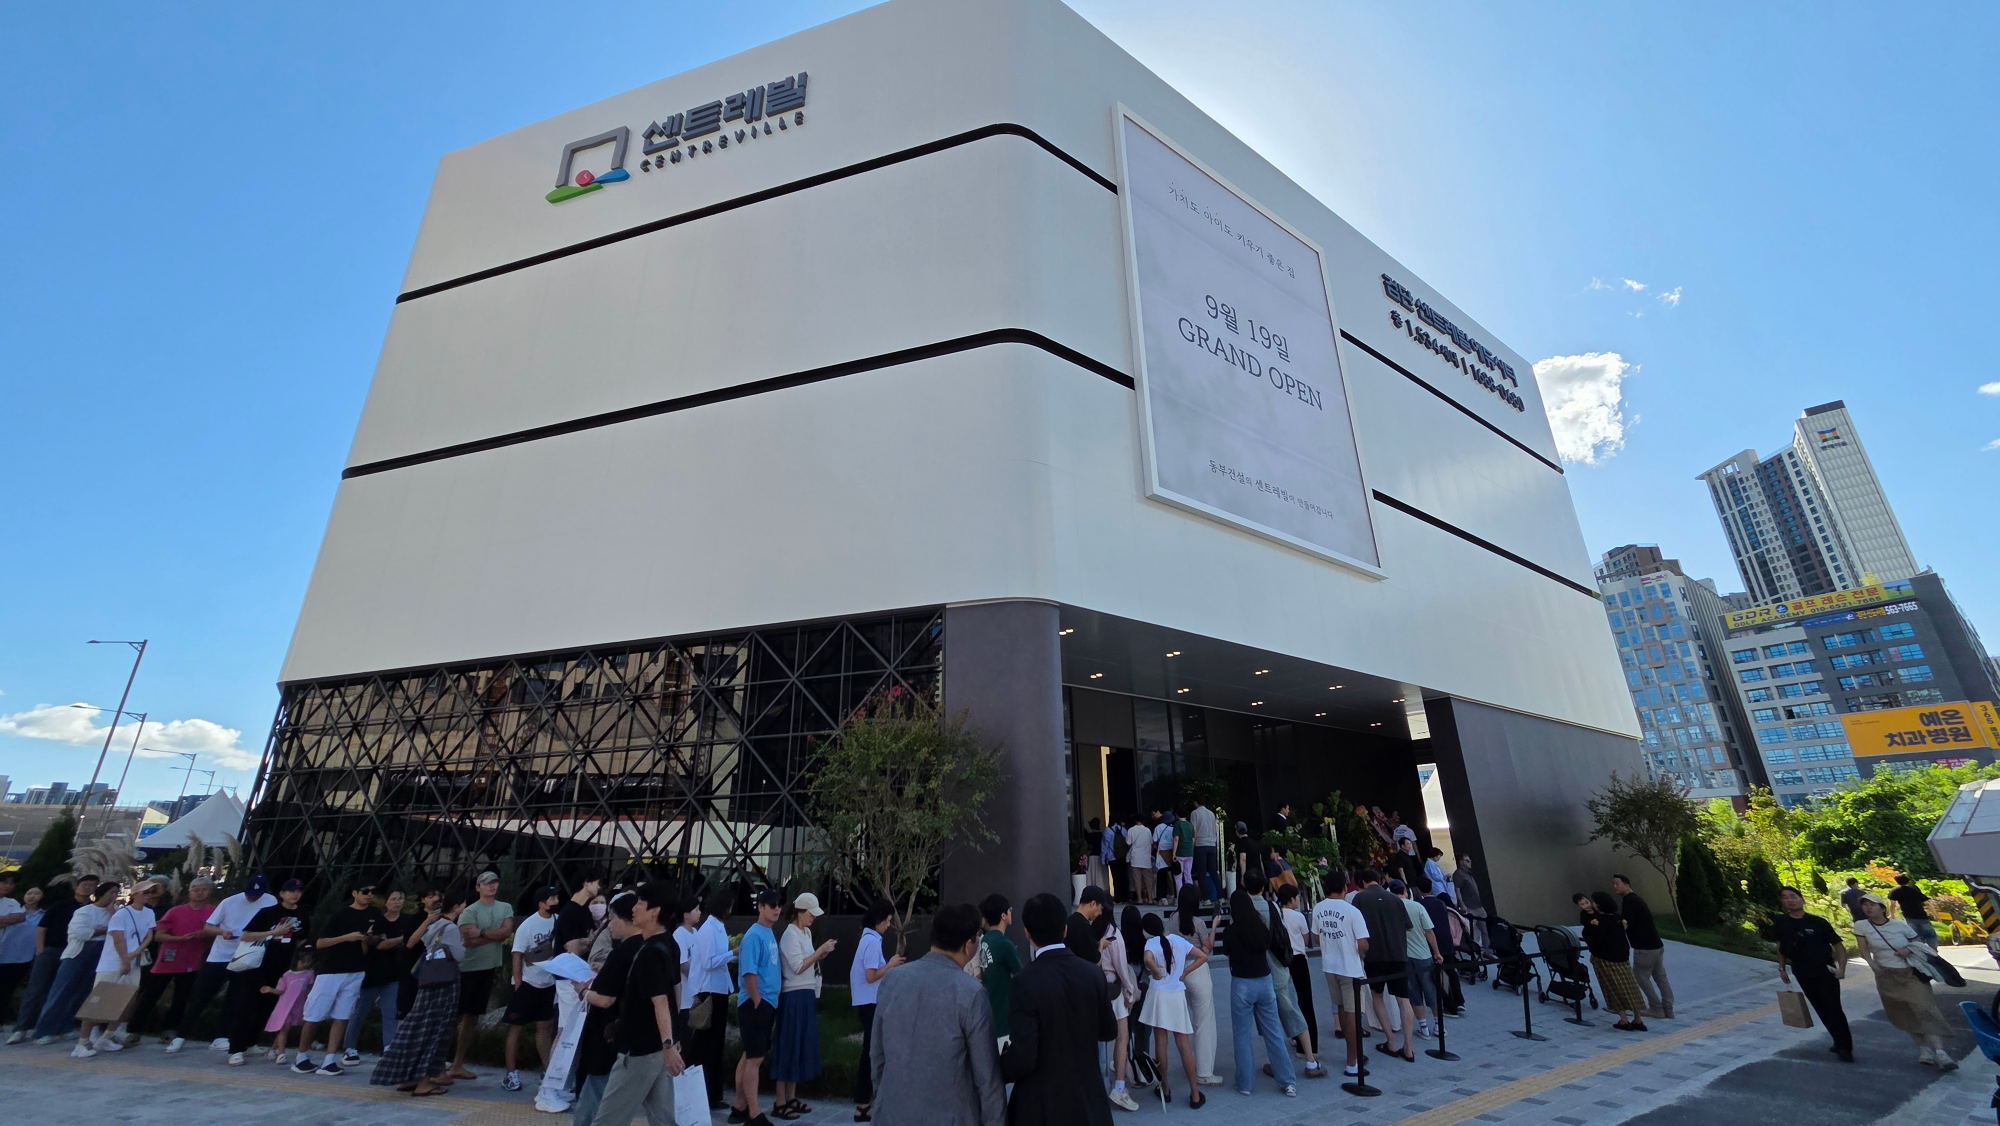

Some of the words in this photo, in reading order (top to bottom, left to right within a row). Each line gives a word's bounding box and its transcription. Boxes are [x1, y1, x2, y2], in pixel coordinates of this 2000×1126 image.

[641, 71, 808, 155] 센트레빌
[639, 111, 804, 173] CENTREVILLE
[1169, 182, 1199, 214] 가치도
[1204, 206, 1233, 237] 아이도
[1237, 233, 1264, 259] 키우기
[1267, 252, 1284, 271] 좋은
[1287, 265, 1295, 279] 집
[1205, 294, 1239, 335] 9월
[1248, 319, 1291, 363] 19일
[1381, 273, 1415, 313] 검단
[1414, 298, 1472, 355] 센트레빌
[1178, 317, 1262, 378] GRAND
[1268, 366, 1322, 411] OPEN
[1209, 459, 1252, 487] 동부건설의
[1255, 479, 1296, 505] 센트레빌이
[1732, 608, 1771, 622] GDR
[1791, 599, 1818, 611] 골프
[1820, 593, 1848, 605] 레슨
[1851, 587, 1878, 600] 전문
[1884, 601, 1918, 616] 563-7665
[1733, 619, 1756, 628] GOLF
[1761, 610, 1806, 622] ACADEMY
[1919, 709, 1965, 727] 예온
[1885, 726, 1974, 747] 치과병원
[1317, 909, 1345, 922] FLORIDA
